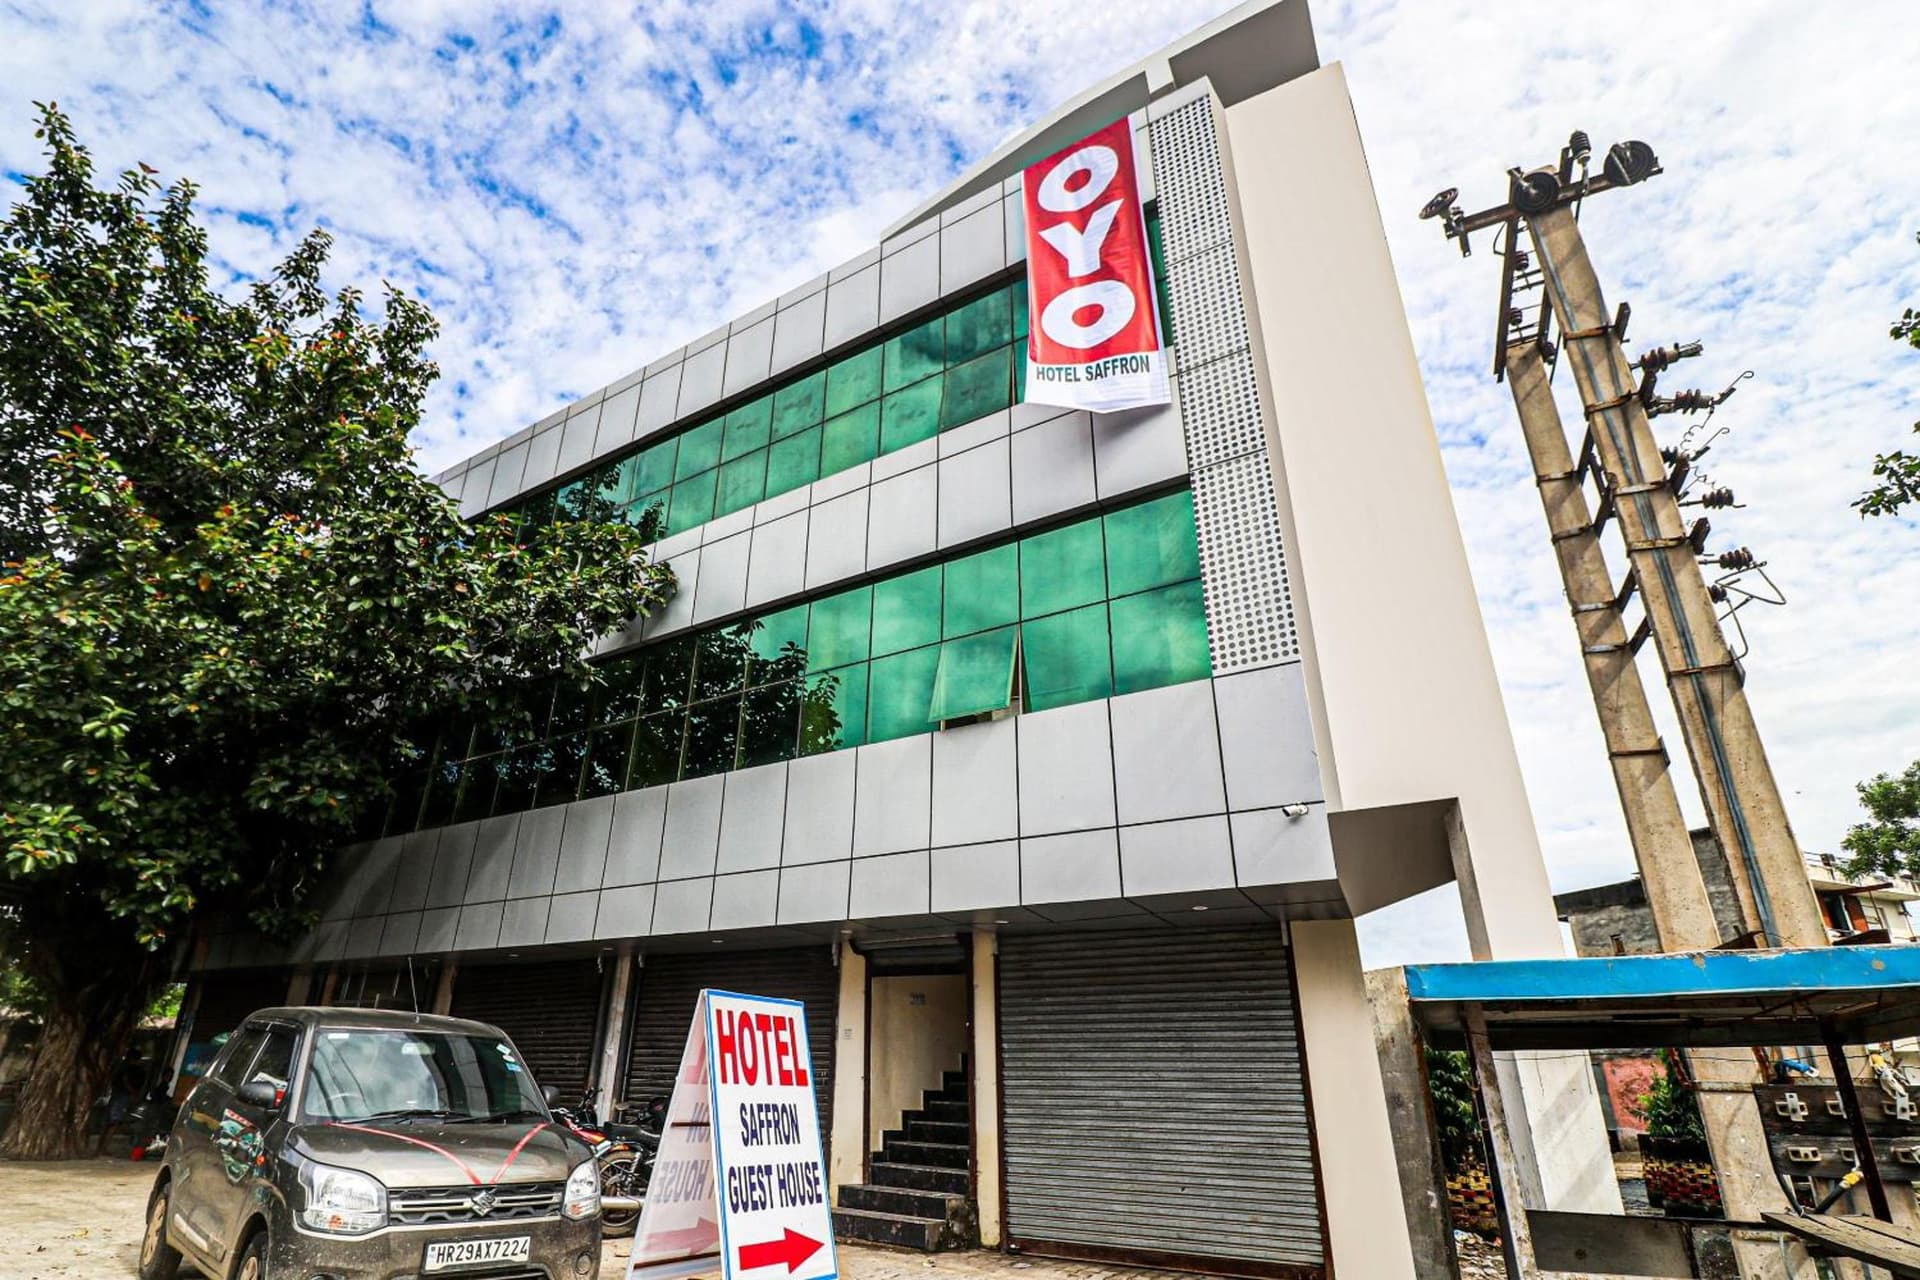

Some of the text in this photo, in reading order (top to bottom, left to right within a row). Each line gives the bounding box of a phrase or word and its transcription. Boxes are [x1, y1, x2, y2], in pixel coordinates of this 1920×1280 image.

[1037, 145, 1136, 349] OYO
[1036, 355, 1150, 382] HOTEL SAFFRON
[716, 1008, 808, 1087] HOTEL
[740, 1102, 801, 1147] SAFFRON
[728, 1161, 823, 1214] GUEST HOUSE
[436, 1239, 529, 1264] HR29AX7224
